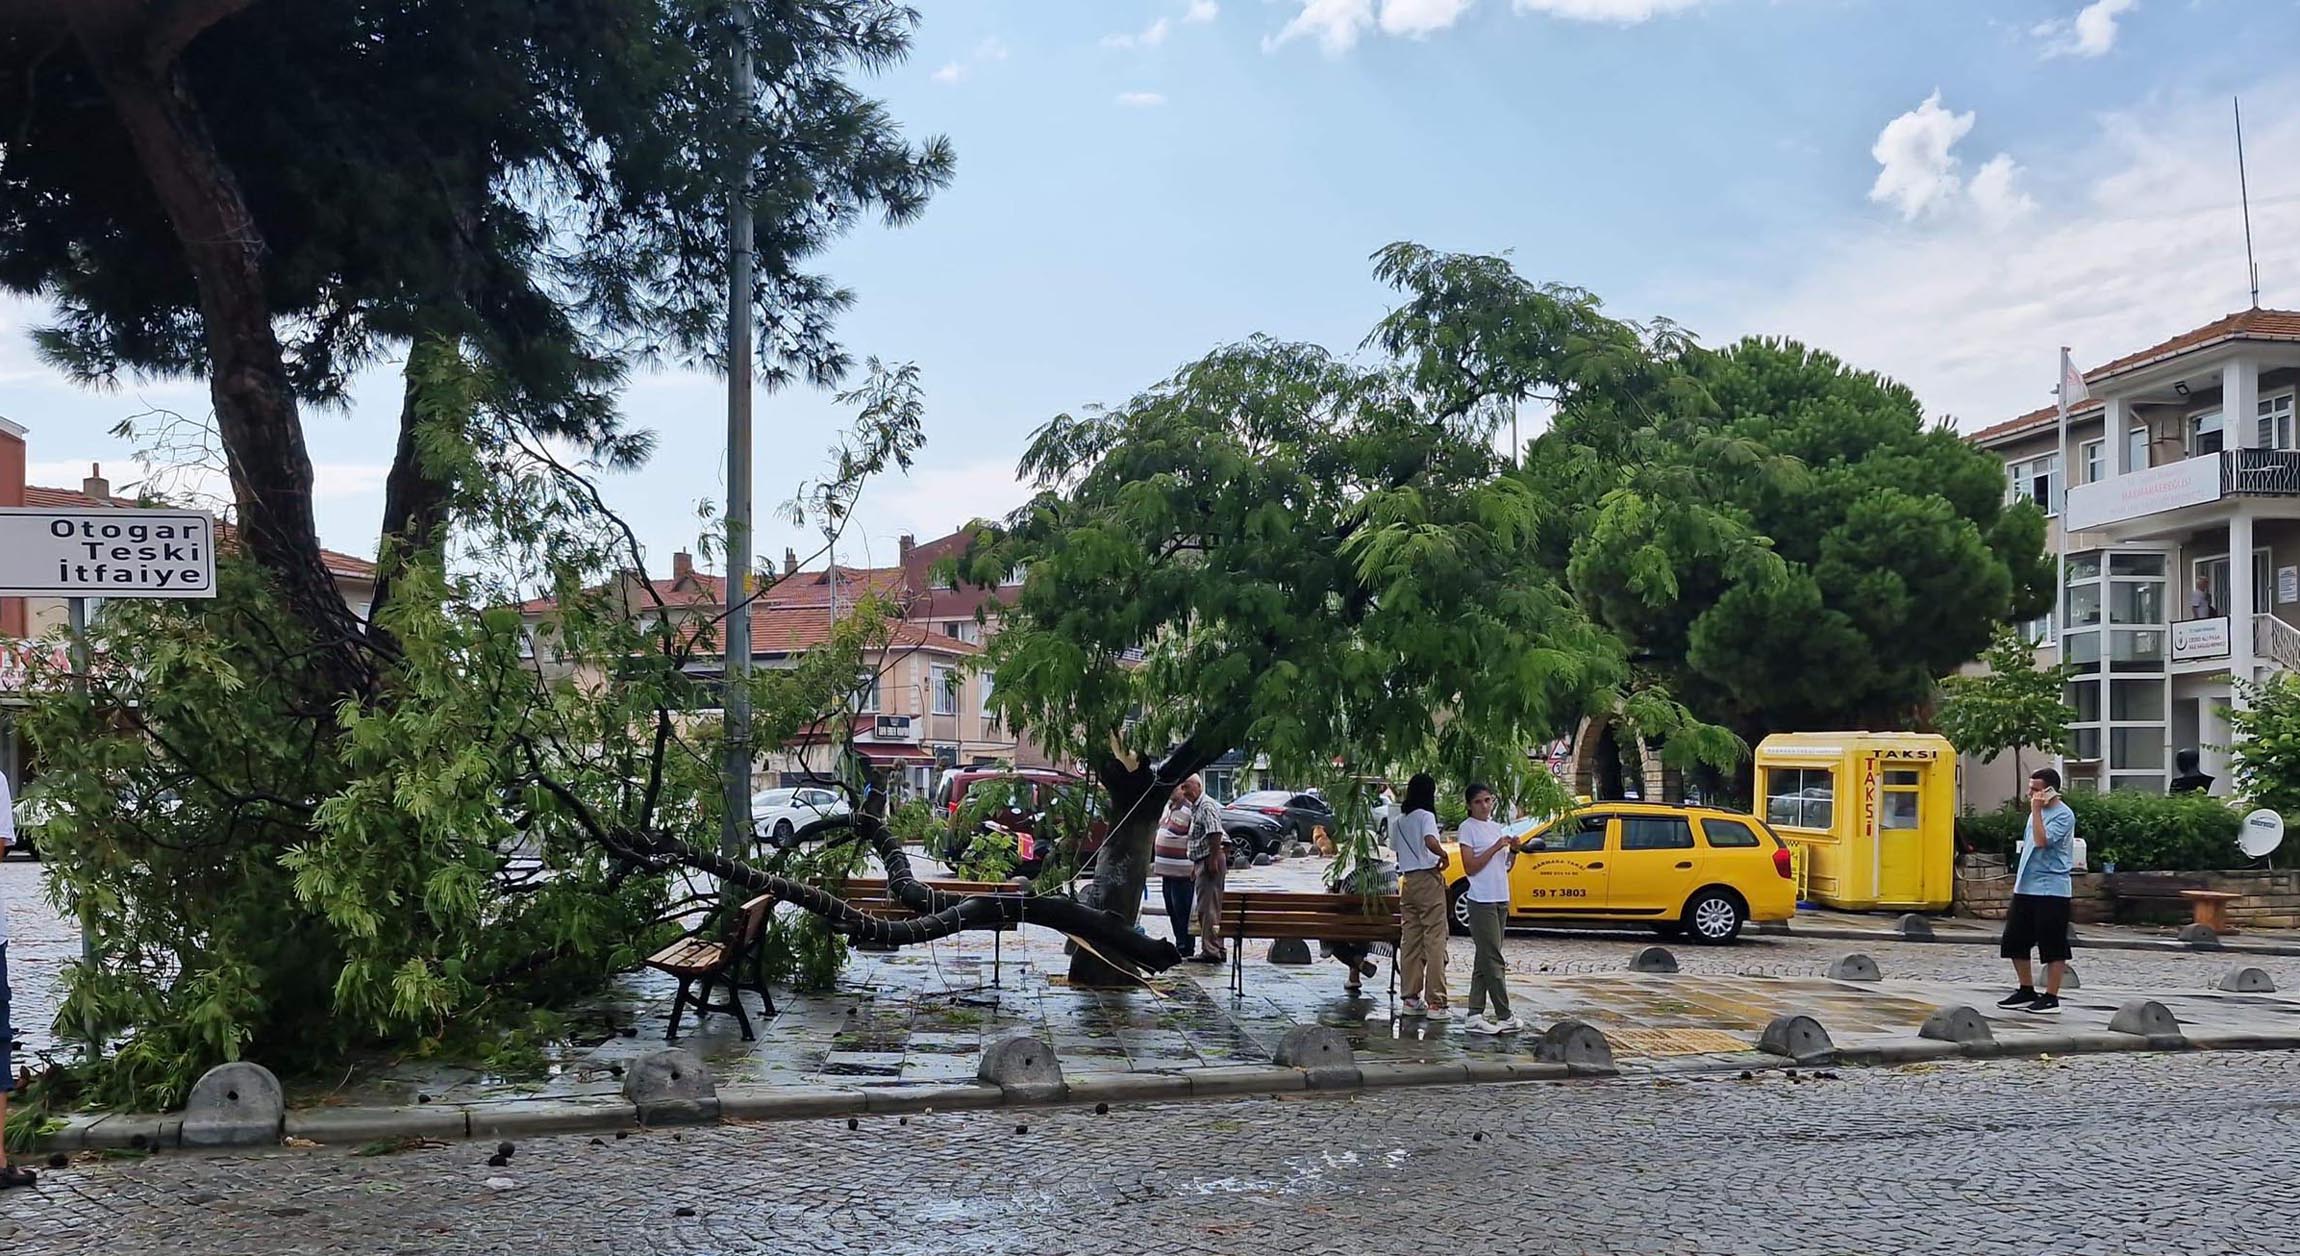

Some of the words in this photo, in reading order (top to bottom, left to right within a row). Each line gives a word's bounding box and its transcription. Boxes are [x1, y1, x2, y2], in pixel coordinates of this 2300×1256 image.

[50, 519, 200, 543] Otogar
[81, 541, 200, 562] Teski
[59, 558, 201, 587] İtfaiye
[1532, 888, 1547, 898] 59
[1549, 888, 1558, 898] T
[1559, 888, 1586, 898] 3803
